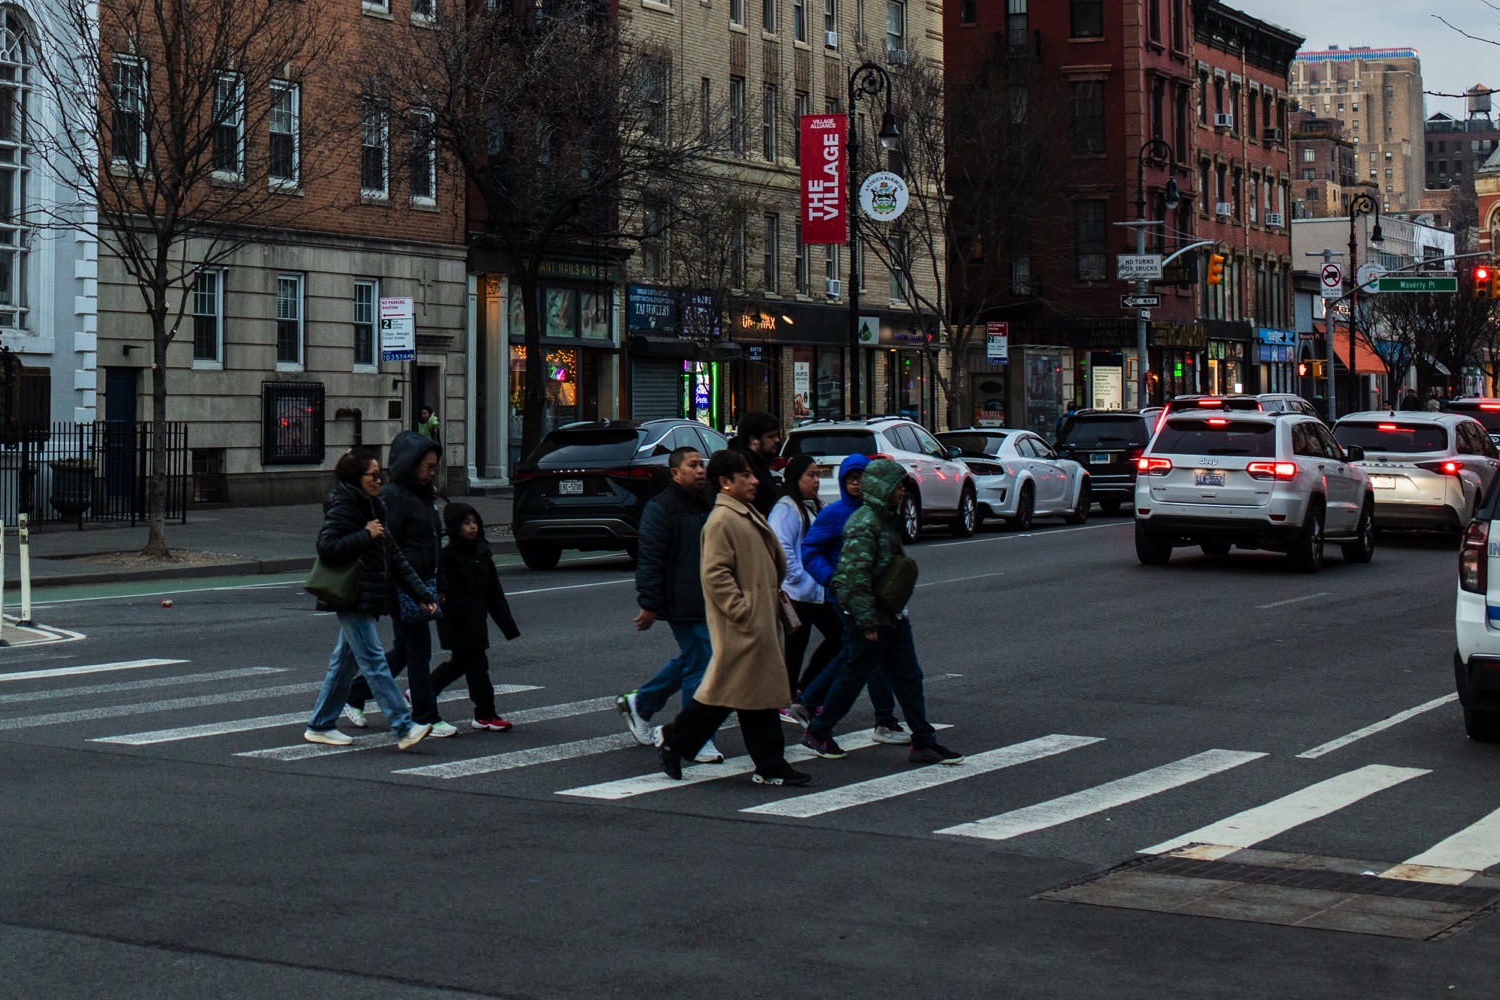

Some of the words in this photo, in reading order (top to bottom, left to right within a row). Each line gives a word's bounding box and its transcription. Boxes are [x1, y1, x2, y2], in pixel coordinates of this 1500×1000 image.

[823, 134, 839, 221] VILLAGE
[808, 180, 824, 221] THE
[559, 261, 580, 275] NAILS
[1400, 281, 1426, 290] Waverly
[1429, 280, 1436, 288] Pl
[383, 319, 390, 329] 2
[1091, 328, 1128, 337] LUNCH
[1199, 458, 1218, 466] Jeep
